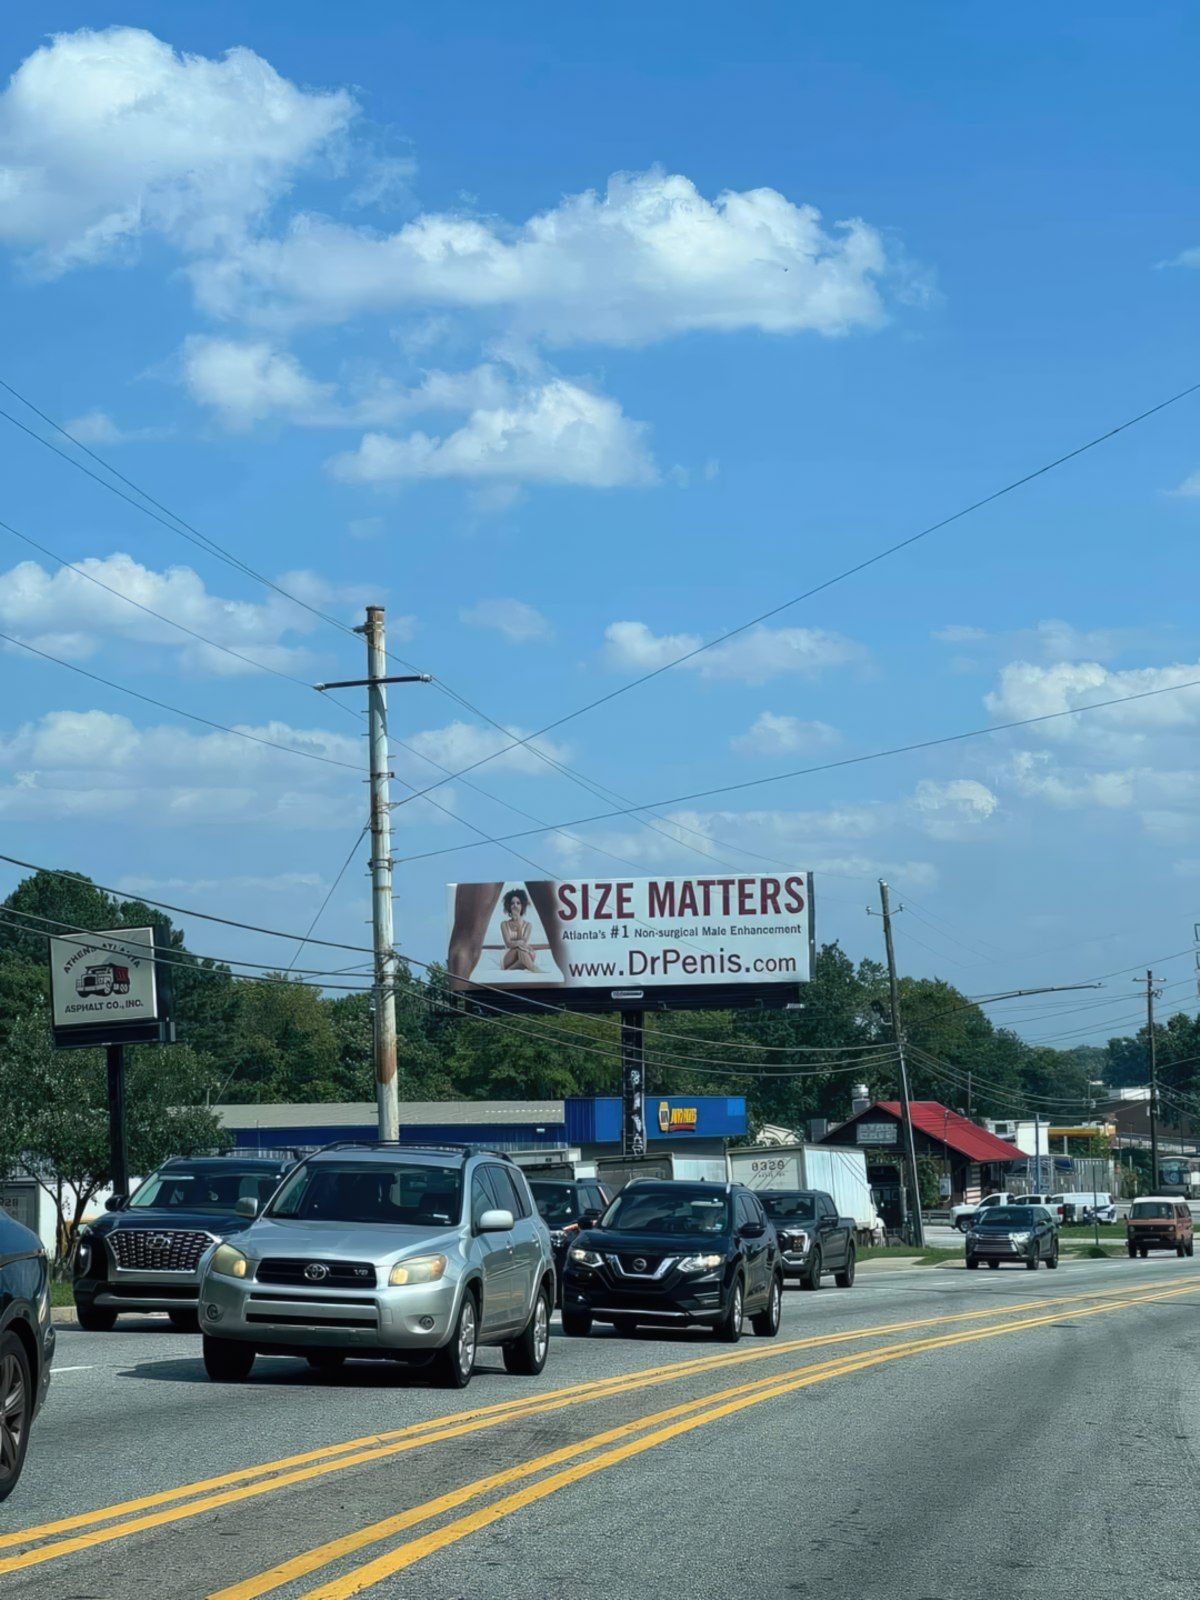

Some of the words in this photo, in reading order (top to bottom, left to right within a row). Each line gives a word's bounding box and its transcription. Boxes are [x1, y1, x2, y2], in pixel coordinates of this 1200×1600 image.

[558, 882, 635, 921] SIZE
[648, 876, 805, 918] MATTERS
[562, 929, 606, 940] Atlanta's
[610, 924, 630, 939] #1
[634, 926, 699, 939] Non-surgical
[702, 925, 727, 936] Male
[730, 924, 802, 936] Enhancement
[569, 947, 797, 977] www.DrPenis.com
[65, 1002, 104, 1013] ASPHALT
